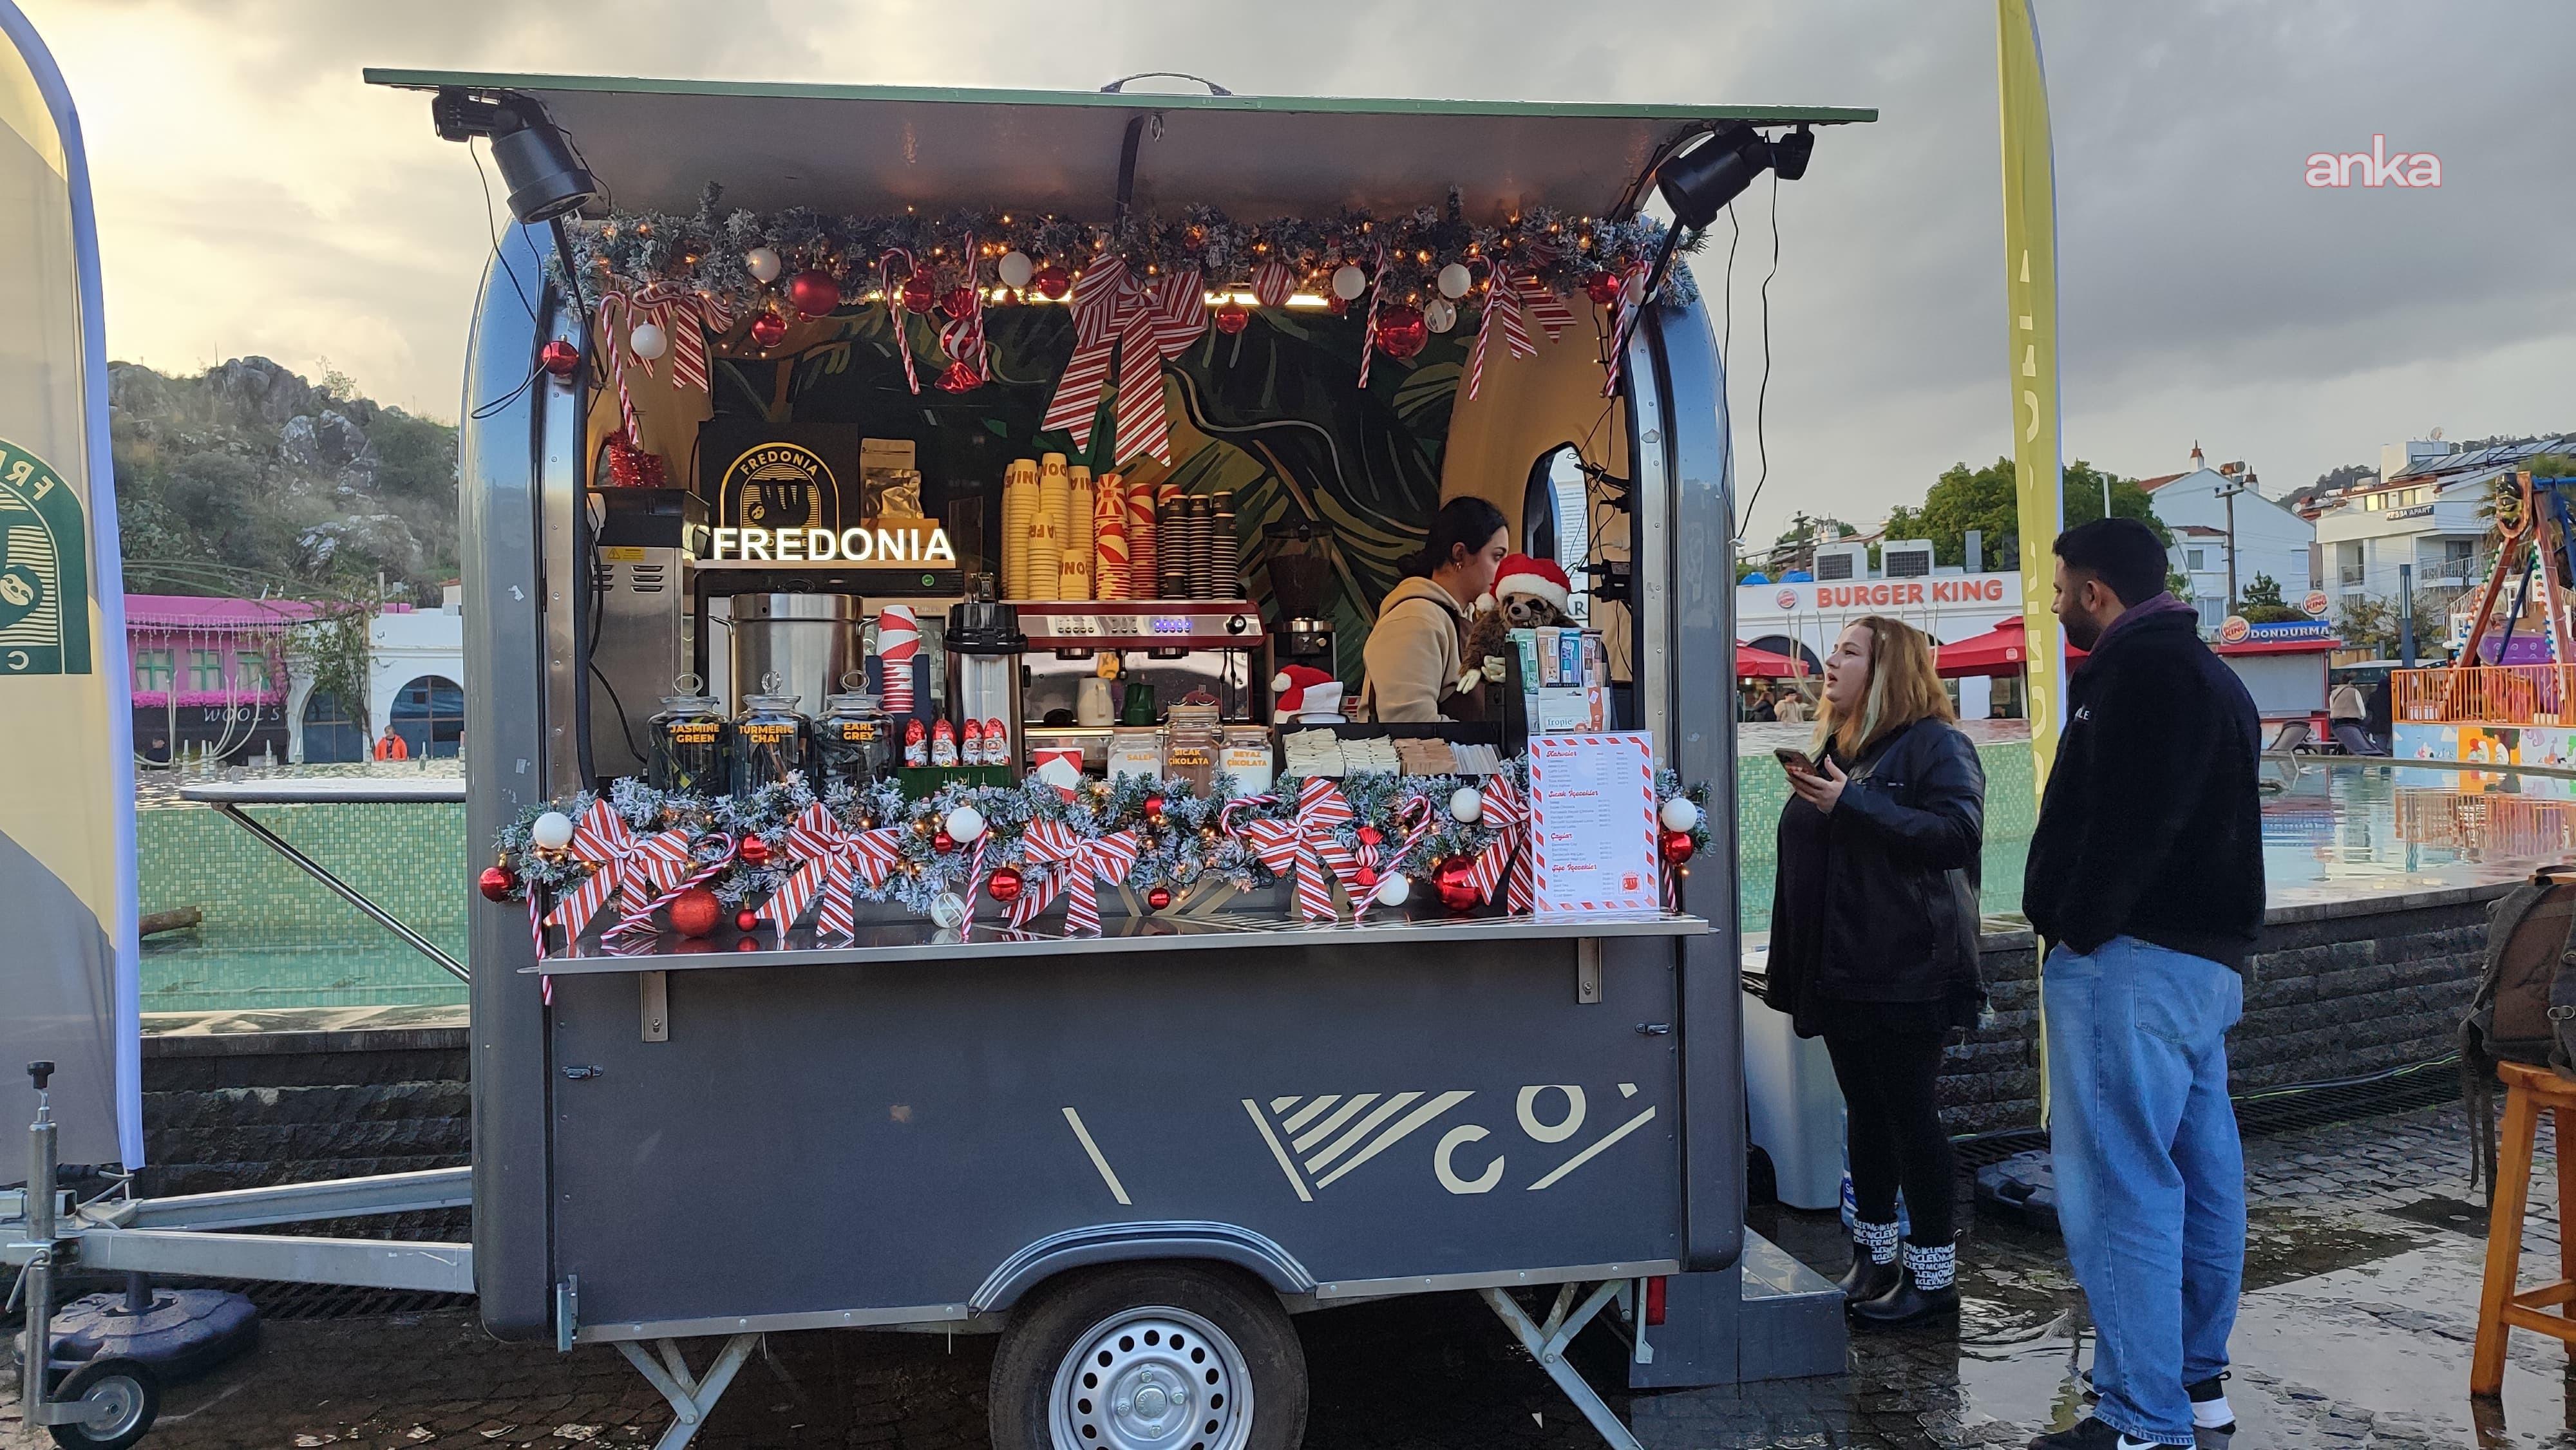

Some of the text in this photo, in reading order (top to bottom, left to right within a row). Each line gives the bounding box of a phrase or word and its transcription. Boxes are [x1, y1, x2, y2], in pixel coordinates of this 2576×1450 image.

[740, 451, 819, 477] FREDONIA
[2409, 505, 2432, 515] APART
[712, 527, 956, 561] FREDONIA
[1817, 583, 1924, 608] BURGER
[1932, 579, 2003, 603] KING
[2306, 599, 2327, 610] KING
[2224, 625, 2246, 637] KING
[2251, 626, 2329, 639] DONDURMA
[670, 724, 719, 733] JASMINE
[739, 725, 794, 735] TURMERIC
[843, 723, 874, 731] EARL
[676, 734, 715, 743] GREEN
[751, 735, 779, 743] CHAI
[843, 731, 874, 740] GREY
